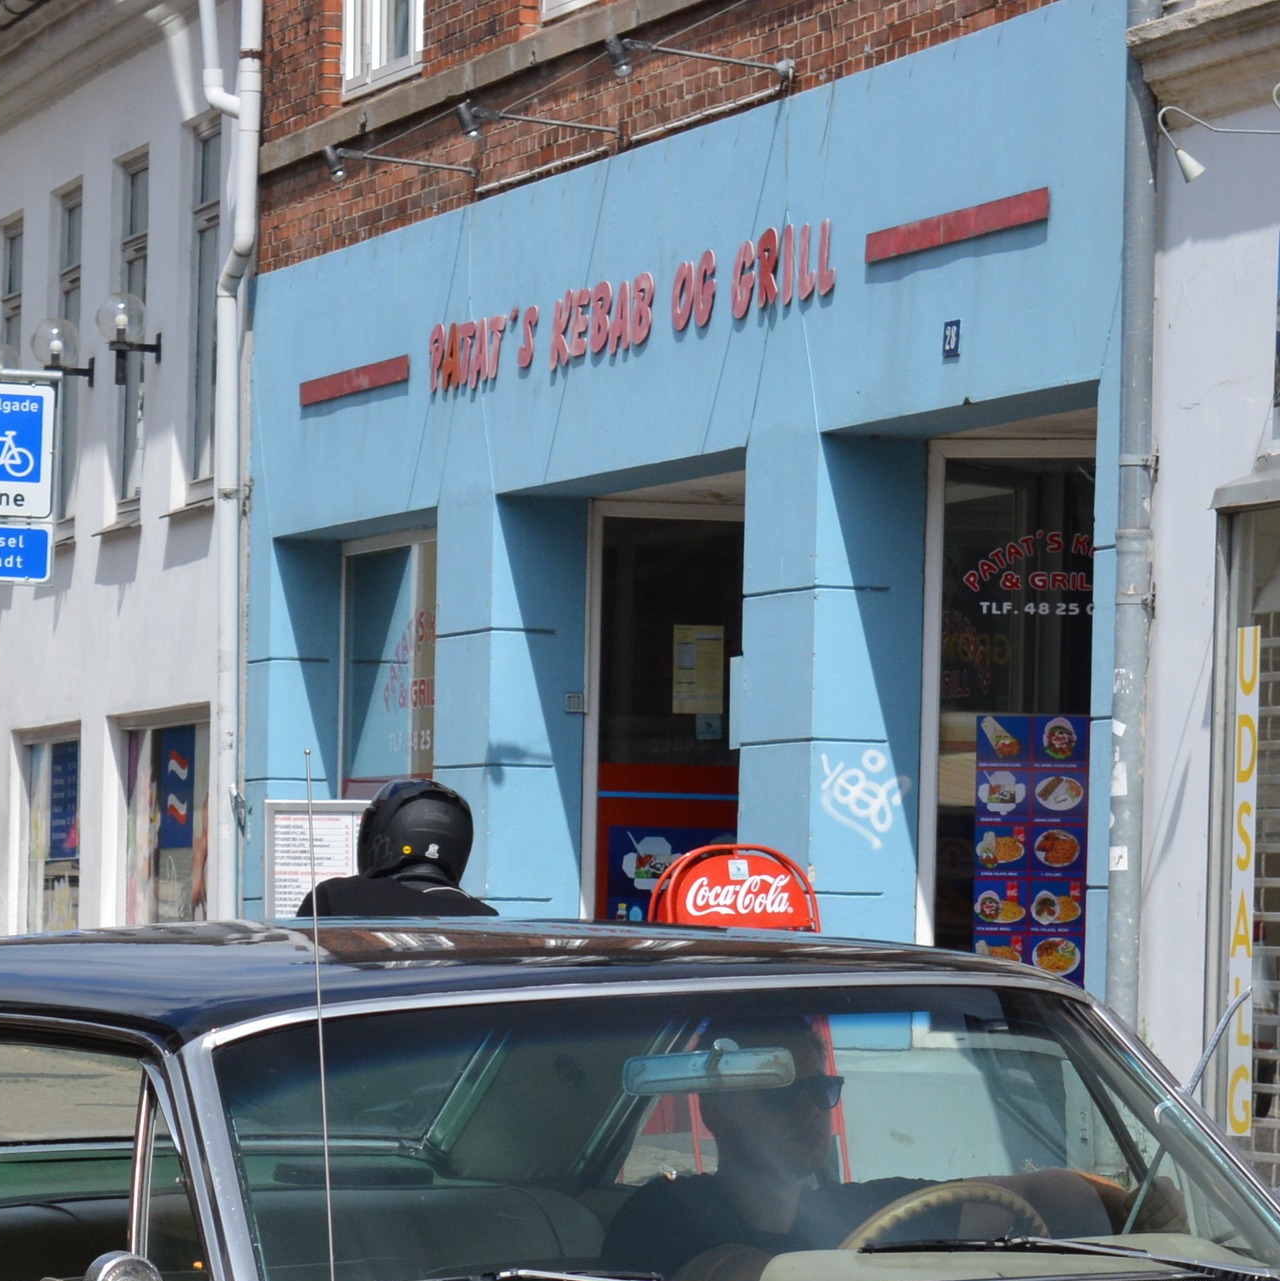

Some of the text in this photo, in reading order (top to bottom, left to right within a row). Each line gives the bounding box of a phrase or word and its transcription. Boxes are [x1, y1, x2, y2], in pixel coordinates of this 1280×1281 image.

[550, 272, 654, 371] KEBAB
[671, 249, 716, 331] OG
[732, 218, 836, 319] GRILL
[945, 325, 957, 350] 28
[1072, 533, 1093, 558] K
[1000, 571, 1021, 590] &
[979, 602, 1019, 615] TLF.
[1024, 602, 1050, 615] 48
[1055, 603, 1079, 615] 25
[1226, 626, 1258, 1135] UDSALG
[686, 874, 791, 916] Coca-Cola
